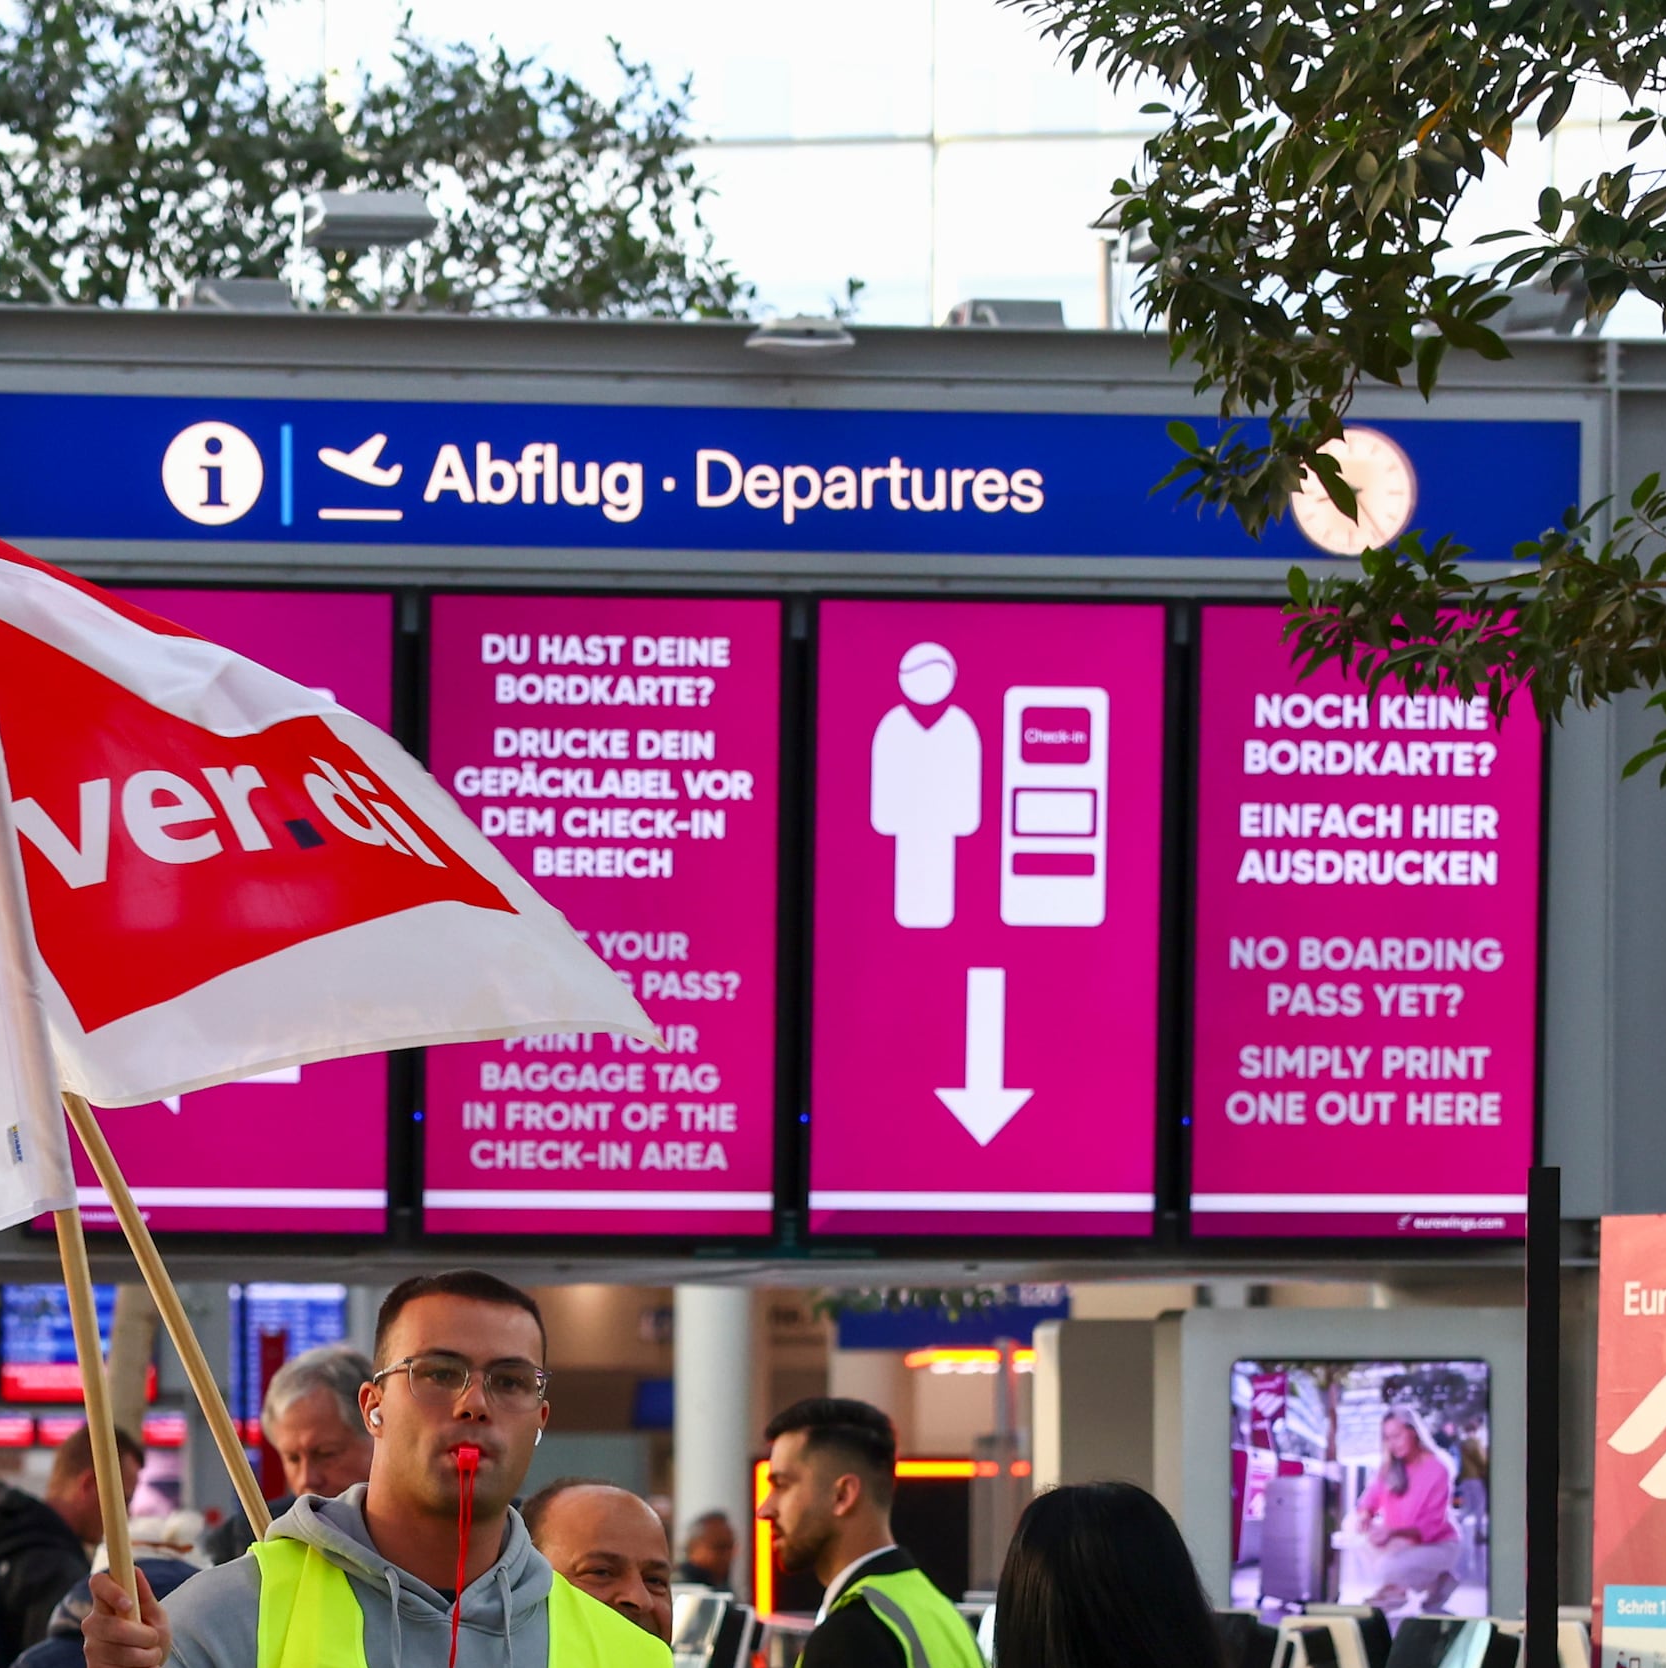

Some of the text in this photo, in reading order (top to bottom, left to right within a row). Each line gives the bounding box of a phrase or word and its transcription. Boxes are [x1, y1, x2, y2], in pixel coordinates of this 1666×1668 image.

[423, 442, 643, 524] Abflug
[695, 449, 1045, 525] Departures
[482, 634, 731, 667] DU HAST DEINE
[495, 674, 715, 707] BORDKARTE?
[1255, 693, 1489, 731] NOCH KEINE
[493, 728, 715, 760] DRUCKE DEIN
[1243, 739, 1498, 778] BORDKARTE?
[454, 762, 753, 801] GEPÄCKLABEL VOR
[13, 756, 448, 889] ver.di
[482, 806, 725, 839] DEM CHECK-IN
[1239, 802, 1499, 840] EINFACH HIER
[533, 847, 672, 878] BEREICH
[1236, 849, 1498, 886] AUSDRUCKEN
[597, 931, 689, 962] YOUR
[1229, 936, 1505, 973] NO BOARDING
[642, 971, 741, 1001] PASS?
[1267, 983, 1464, 1018] PASS YET?
[480, 1062, 721, 1093] BAGGAGE TAG
[1238, 1045, 1491, 1080] SIMPLY PRINT
[462, 1101, 738, 1133] IN FRONT OF THE
[1225, 1091, 1502, 1127] ONE OUT HERE
[469, 1140, 728, 1171] CHECK-IN AREA
[1617, 1599, 1657, 1615] Schritt
